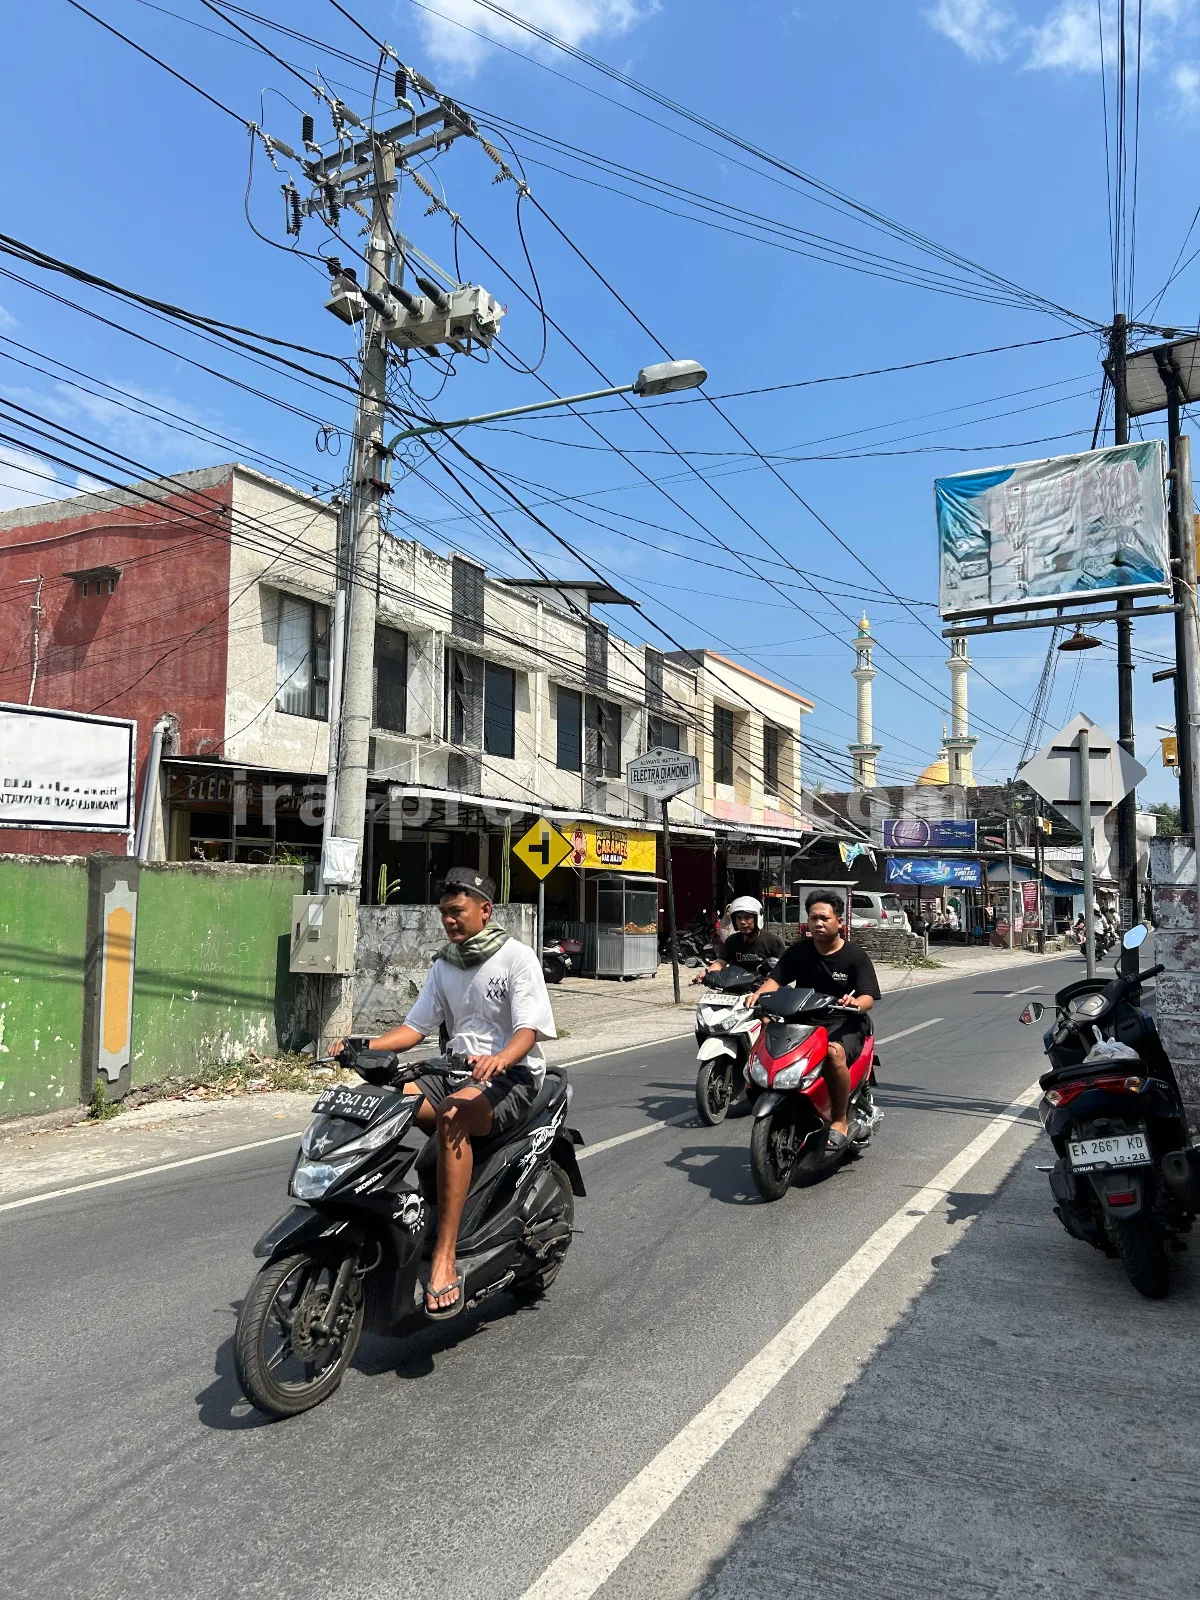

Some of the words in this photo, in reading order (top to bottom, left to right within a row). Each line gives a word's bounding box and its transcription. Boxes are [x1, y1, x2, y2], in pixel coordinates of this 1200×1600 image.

[633, 768, 660, 782] ELECTRA
[661, 765, 689, 779] DIAMOND
[596, 839, 628, 858] CARAMEL
[318, 1090, 335, 1102] DR
[335, 1092, 362, 1106] 5341
[361, 1096, 380, 1108] CV
[1072, 1144, 1088, 1157] EA
[1092, 1139, 1119, 1154] 2667
[1127, 1136, 1143, 1150] KD
[354, 1172, 384, 1194] HONDA
